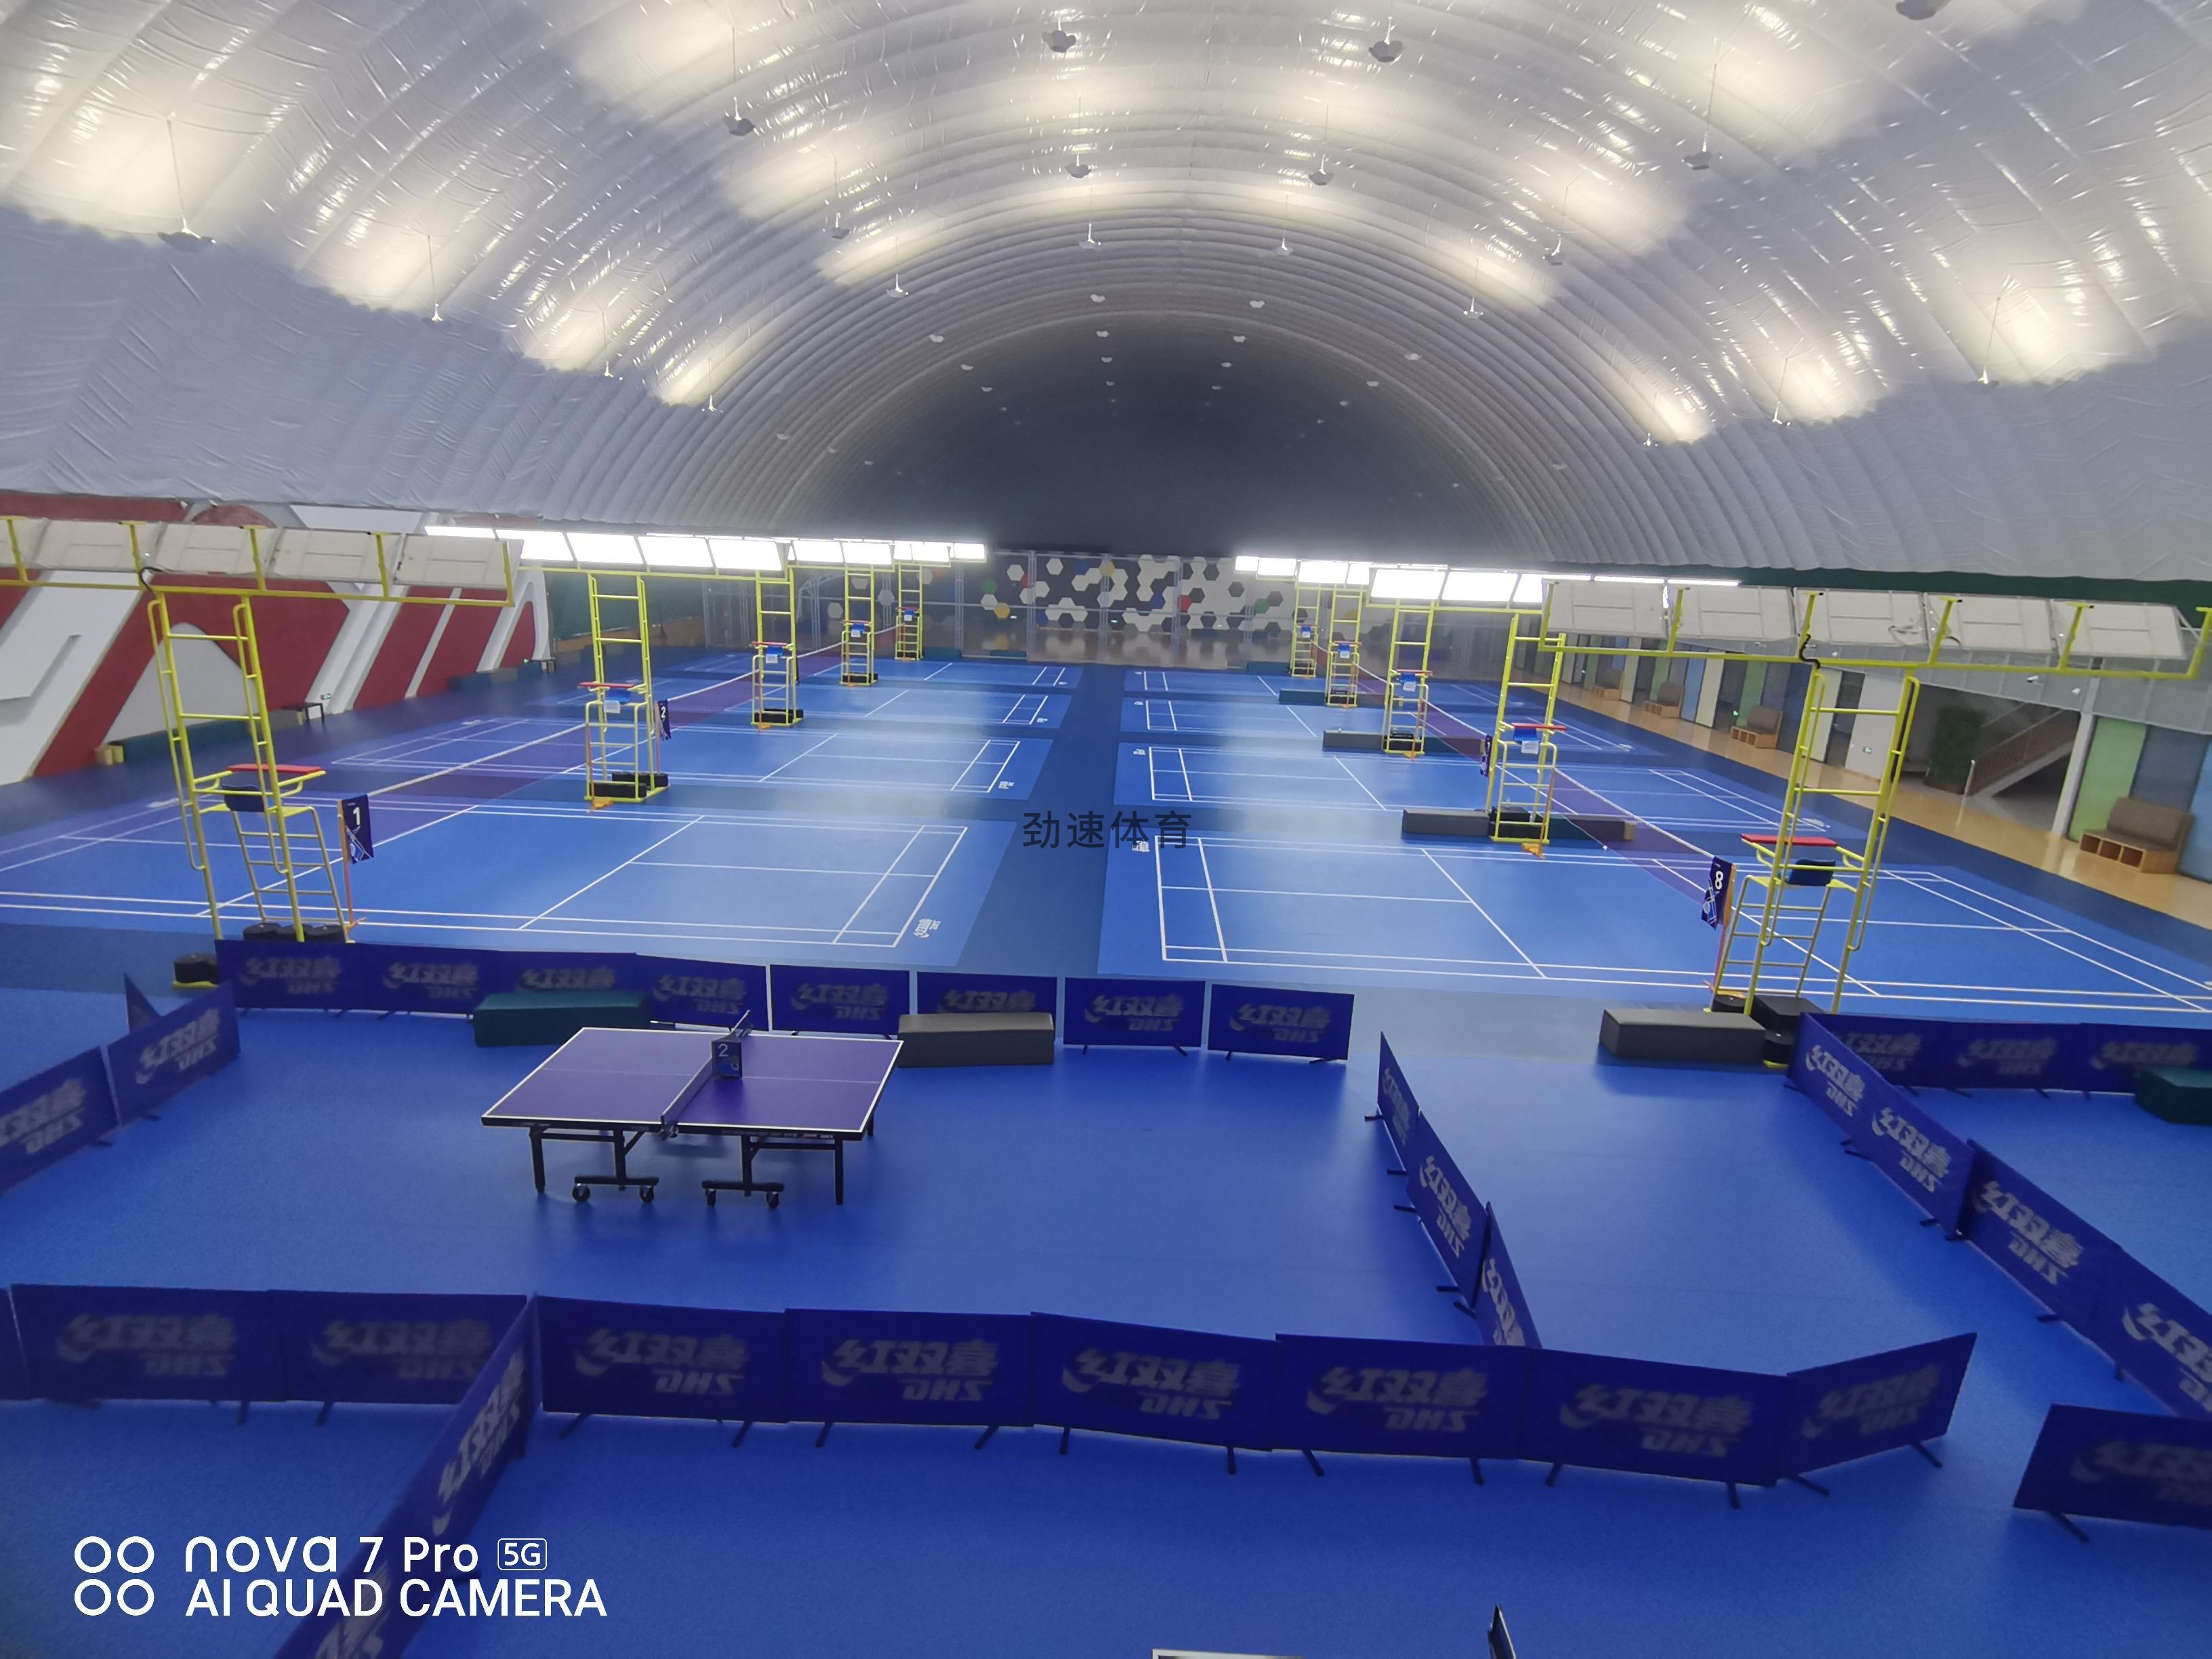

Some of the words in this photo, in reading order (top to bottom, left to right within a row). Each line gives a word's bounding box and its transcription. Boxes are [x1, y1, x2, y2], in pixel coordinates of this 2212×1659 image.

[353, 807, 361, 825] 1
[1715, 871, 1724, 890] 8
[718, 1044, 729, 1057] 2
[1879, 1107, 1952, 1178] 红双喜
[832, 1339, 1000, 1376] 红双喜
[1074, 1349, 1241, 1399] 红双喜
[1319, 1367, 1489, 1406] 红双喜
